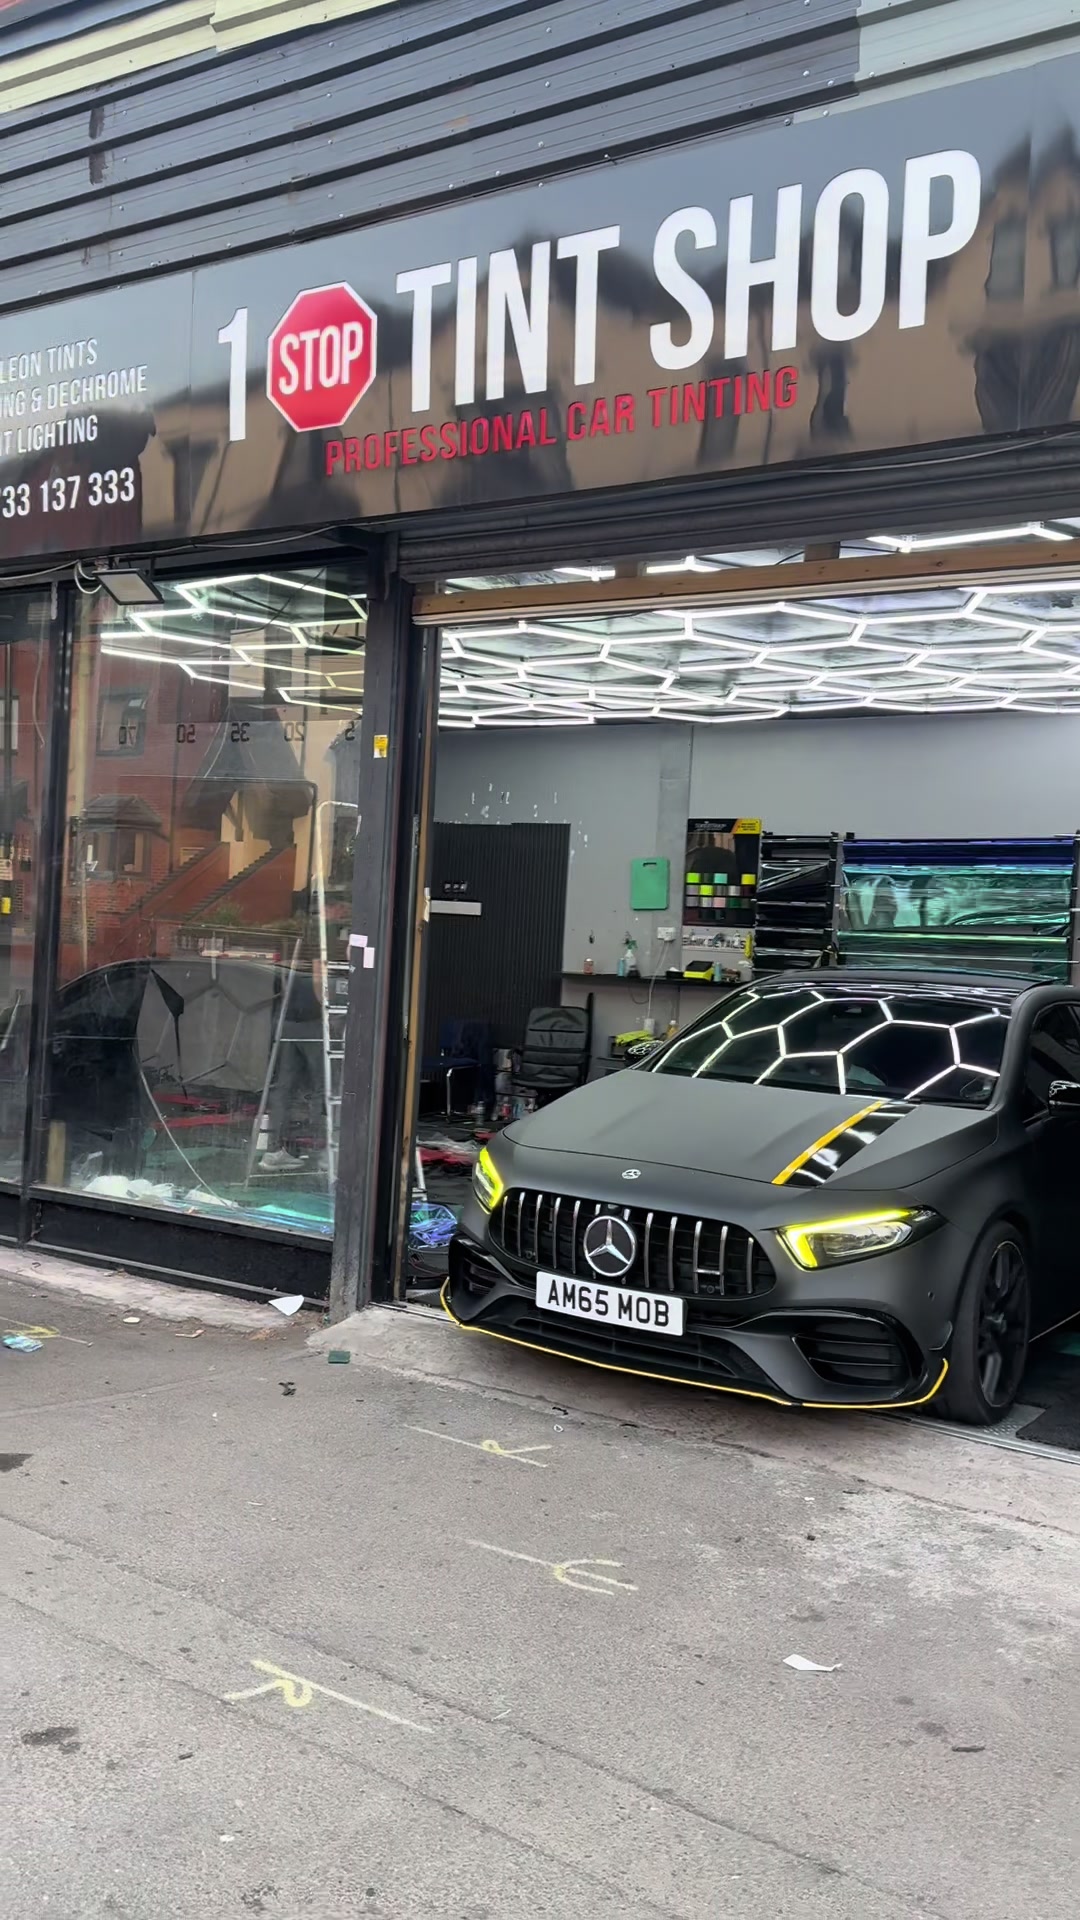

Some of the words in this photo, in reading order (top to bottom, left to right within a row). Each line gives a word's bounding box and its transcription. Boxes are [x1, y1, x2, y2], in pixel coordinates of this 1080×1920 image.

[217, 307, 248, 442] 1
[278, 321, 364, 396] STOP
[396, 225, 621, 413] TINT
[650, 149, 982, 371] SHOP
[46, 337, 98, 374] TINTS
[31, 387, 42, 414] &
[47, 364, 148, 410] DECHROME
[18, 414, 98, 454] LIGHTING
[325, 408, 557, 477] PROFESSIONAL
[567, 394, 636, 440] CAR
[648, 365, 799, 428] TINTING
[0, 483, 31, 518] 33
[40, 475, 81, 513] 137
[88, 467, 135, 506] 333
[547, 1279, 609, 1316] AM65
[618, 1293, 669, 1327] MOB
